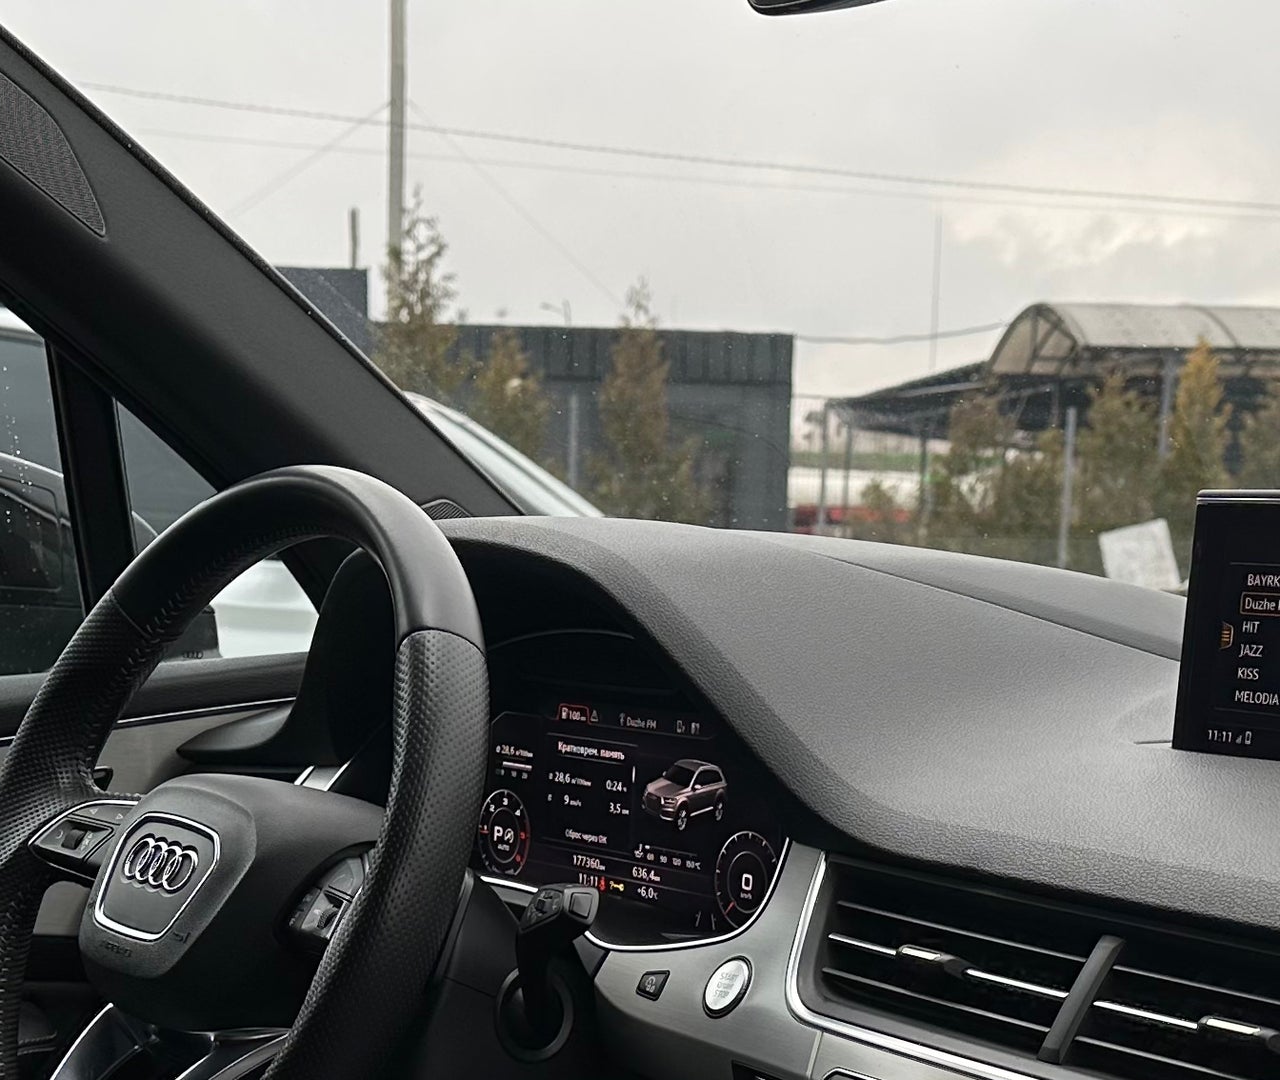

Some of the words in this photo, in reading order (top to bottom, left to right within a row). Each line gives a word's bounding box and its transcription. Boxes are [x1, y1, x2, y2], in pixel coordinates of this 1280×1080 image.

[1244, 598, 1276, 611] Duzhe
[1242, 621, 1259, 634] HIT
[1239, 643, 1263, 658] JAZZ
[1237, 667, 1259, 680] KISS
[1235, 690, 1279, 706] MELODIA
[1207, 729, 1232, 743] 11:11
[554, 771, 570, 784] 28,6
